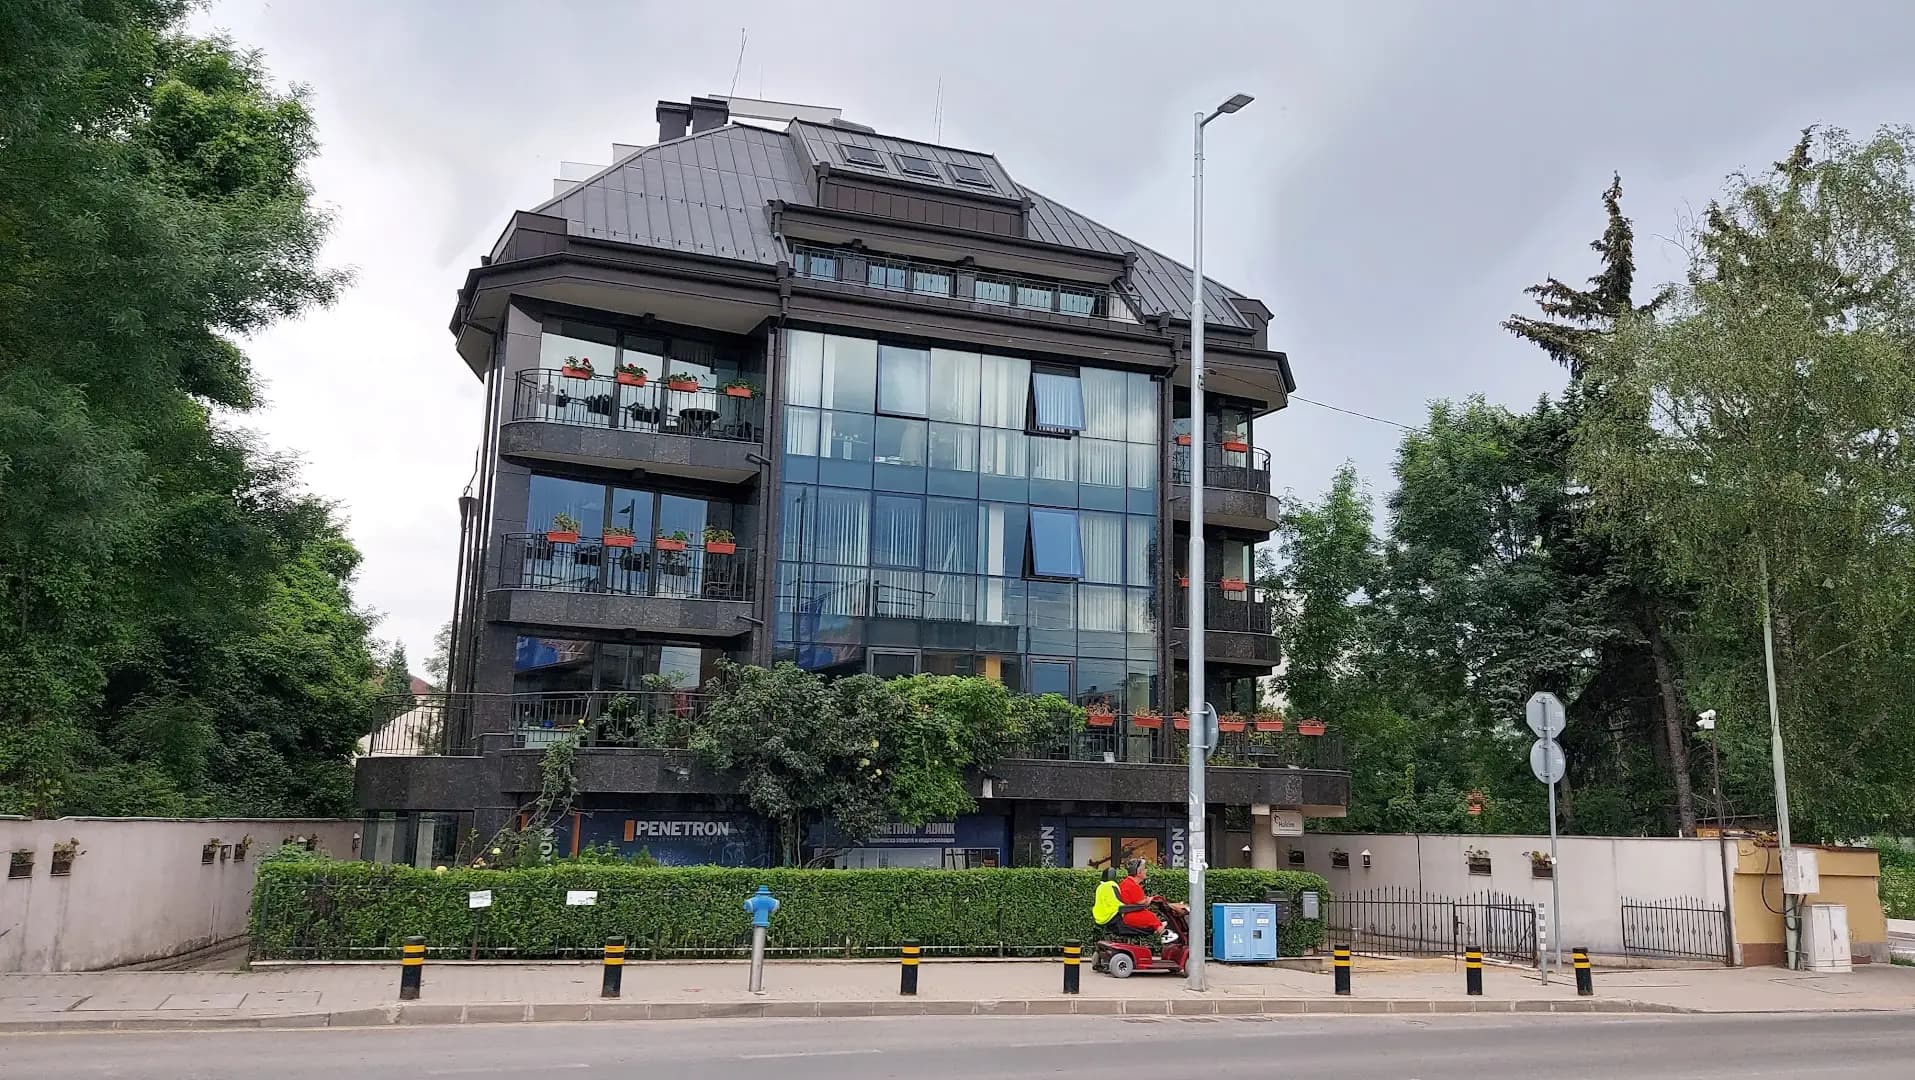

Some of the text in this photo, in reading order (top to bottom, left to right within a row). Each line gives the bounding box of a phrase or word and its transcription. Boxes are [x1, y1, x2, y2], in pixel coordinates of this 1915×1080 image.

[636, 820, 730, 836] PENETRON
[925, 822, 956, 835] ADMIX
[1172, 828, 1185, 867] RON
